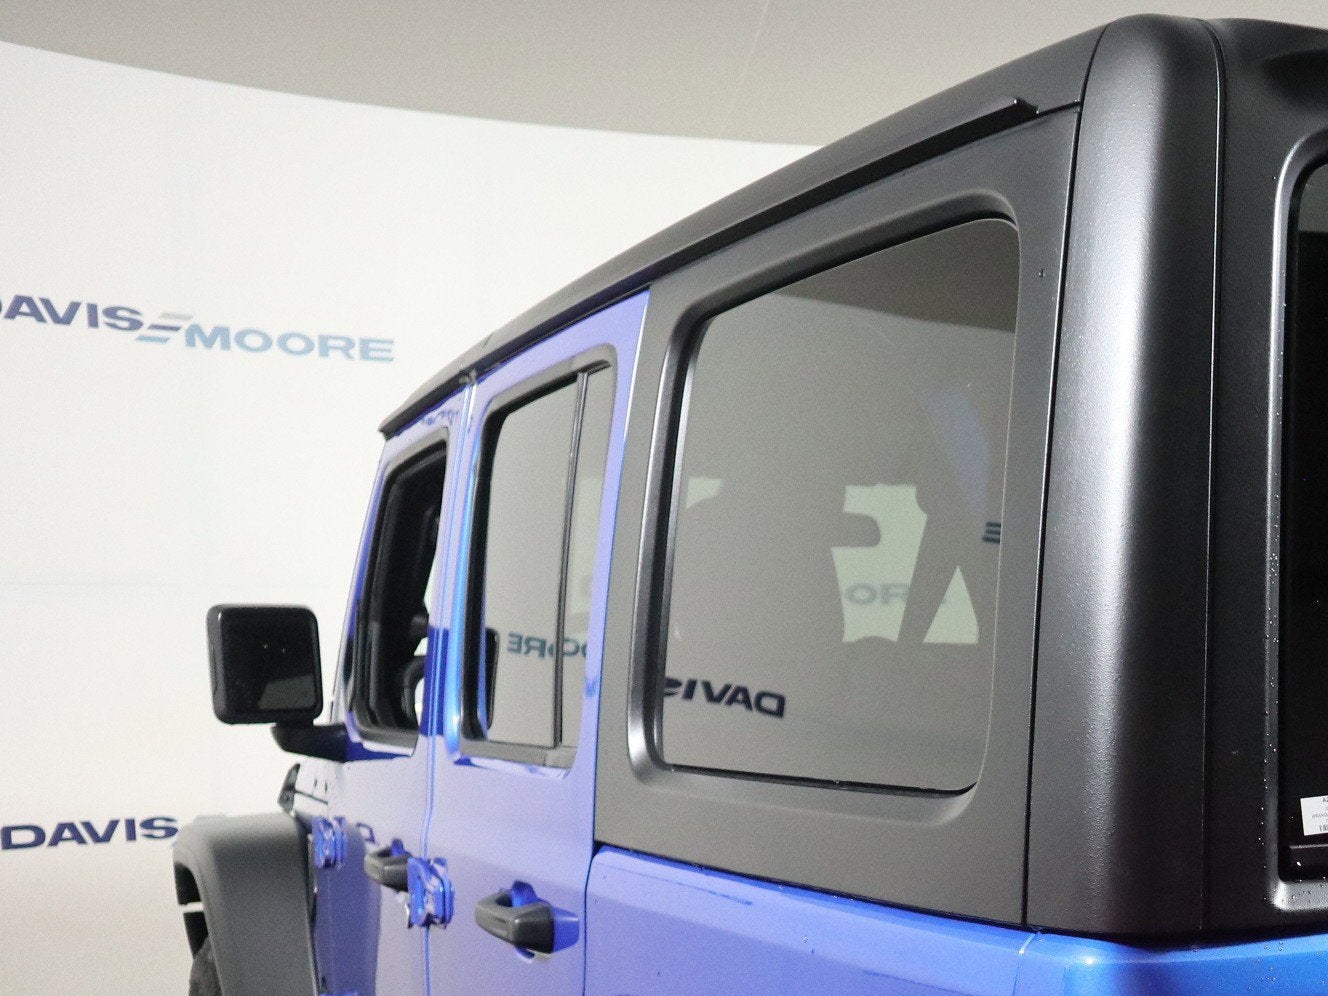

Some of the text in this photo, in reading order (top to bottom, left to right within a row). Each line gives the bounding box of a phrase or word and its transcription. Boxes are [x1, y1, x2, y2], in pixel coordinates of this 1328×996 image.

[0, 294, 395, 362] AVIS MOORE
[1, 816, 179, 850] DAVIS
